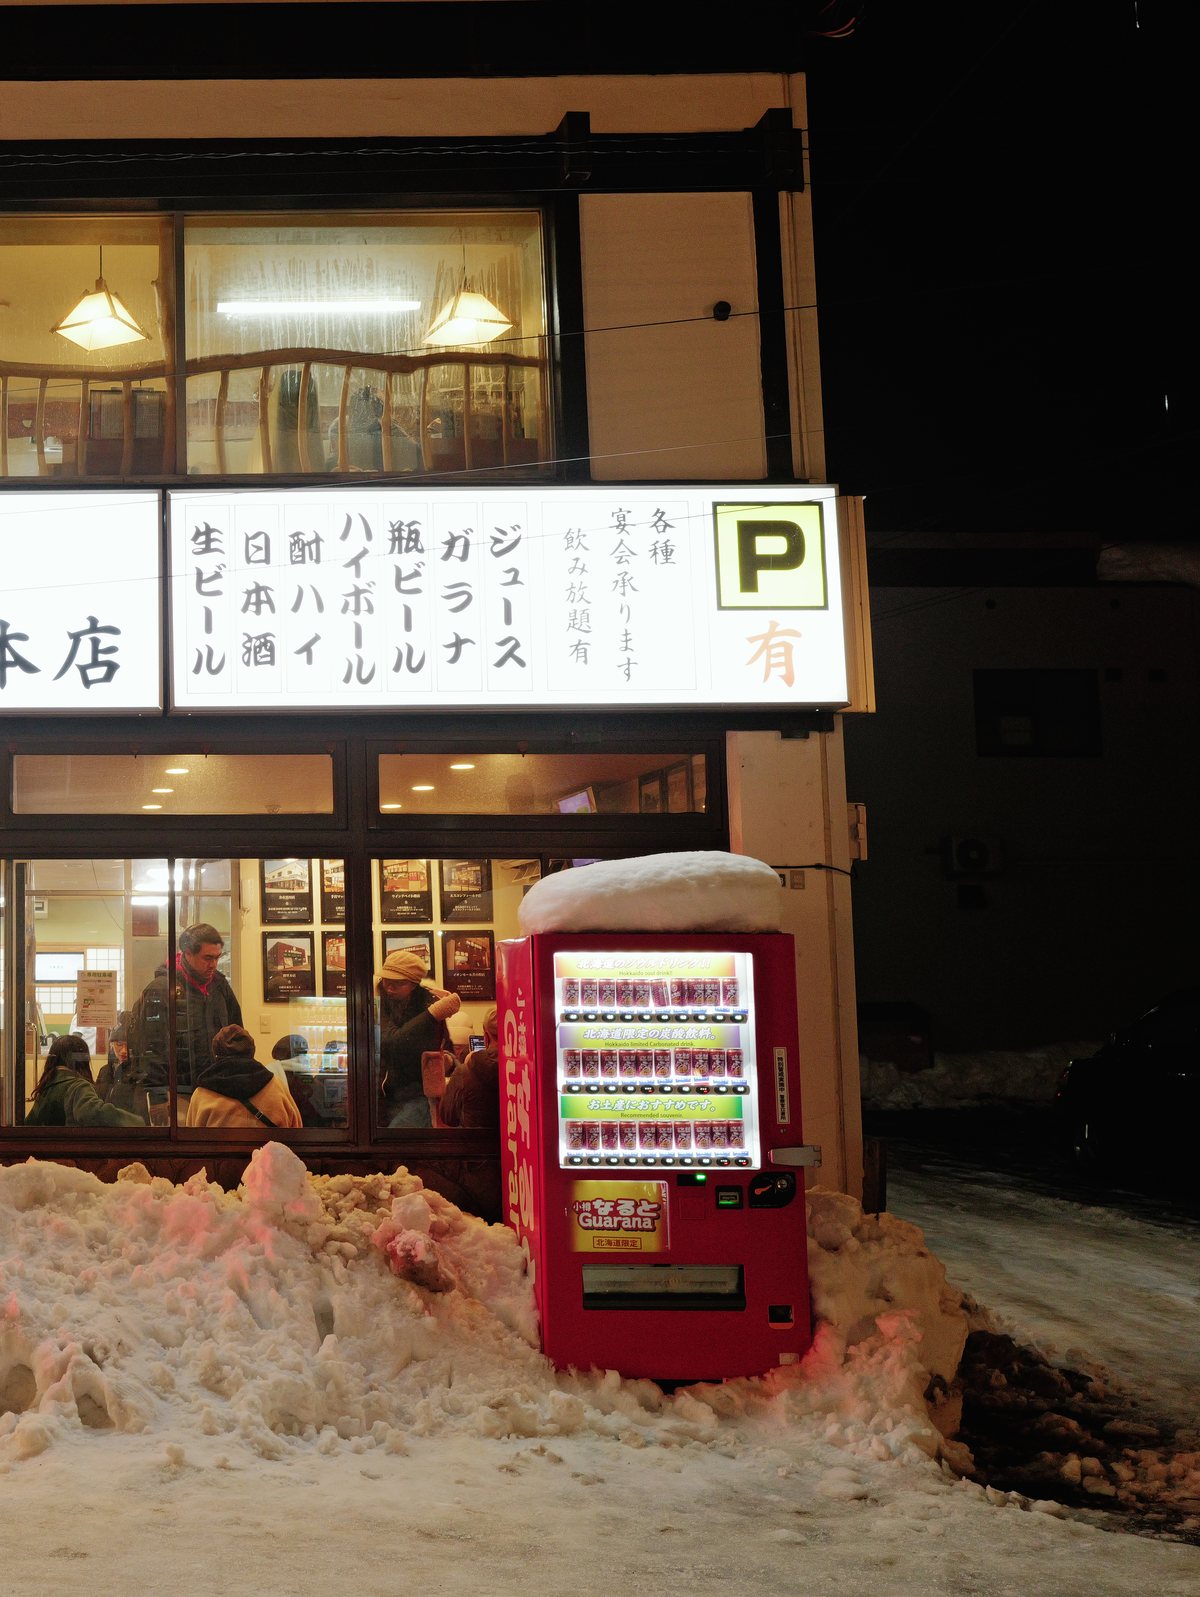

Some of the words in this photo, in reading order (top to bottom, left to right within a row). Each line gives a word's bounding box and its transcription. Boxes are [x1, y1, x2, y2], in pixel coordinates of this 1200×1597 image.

[190, 521, 227, 676] 生ビール
[241, 530, 276, 668] 日本酒
[288, 530, 325, 666] 酎ハイ
[339, 512, 377, 685] ハイボール
[387, 519, 426, 674] 瓶ビール
[440, 527, 476, 665] ガラナ
[489, 524, 527, 668] ジュース
[563, 527, 593, 666] 飲み放題有
[609, 507, 639, 683] 宴会承ります
[648, 507, 677, 566] 各種
[736, 520, 806, 593] P
[745, 620, 802, 688] 有
[588, 1099, 715, 1112] お土産におすすめです。
[578, 1212, 652, 1229] Guarana
[593, 1199, 658, 1217] なると
[596, 1238, 638, 1248] 北海道限定
